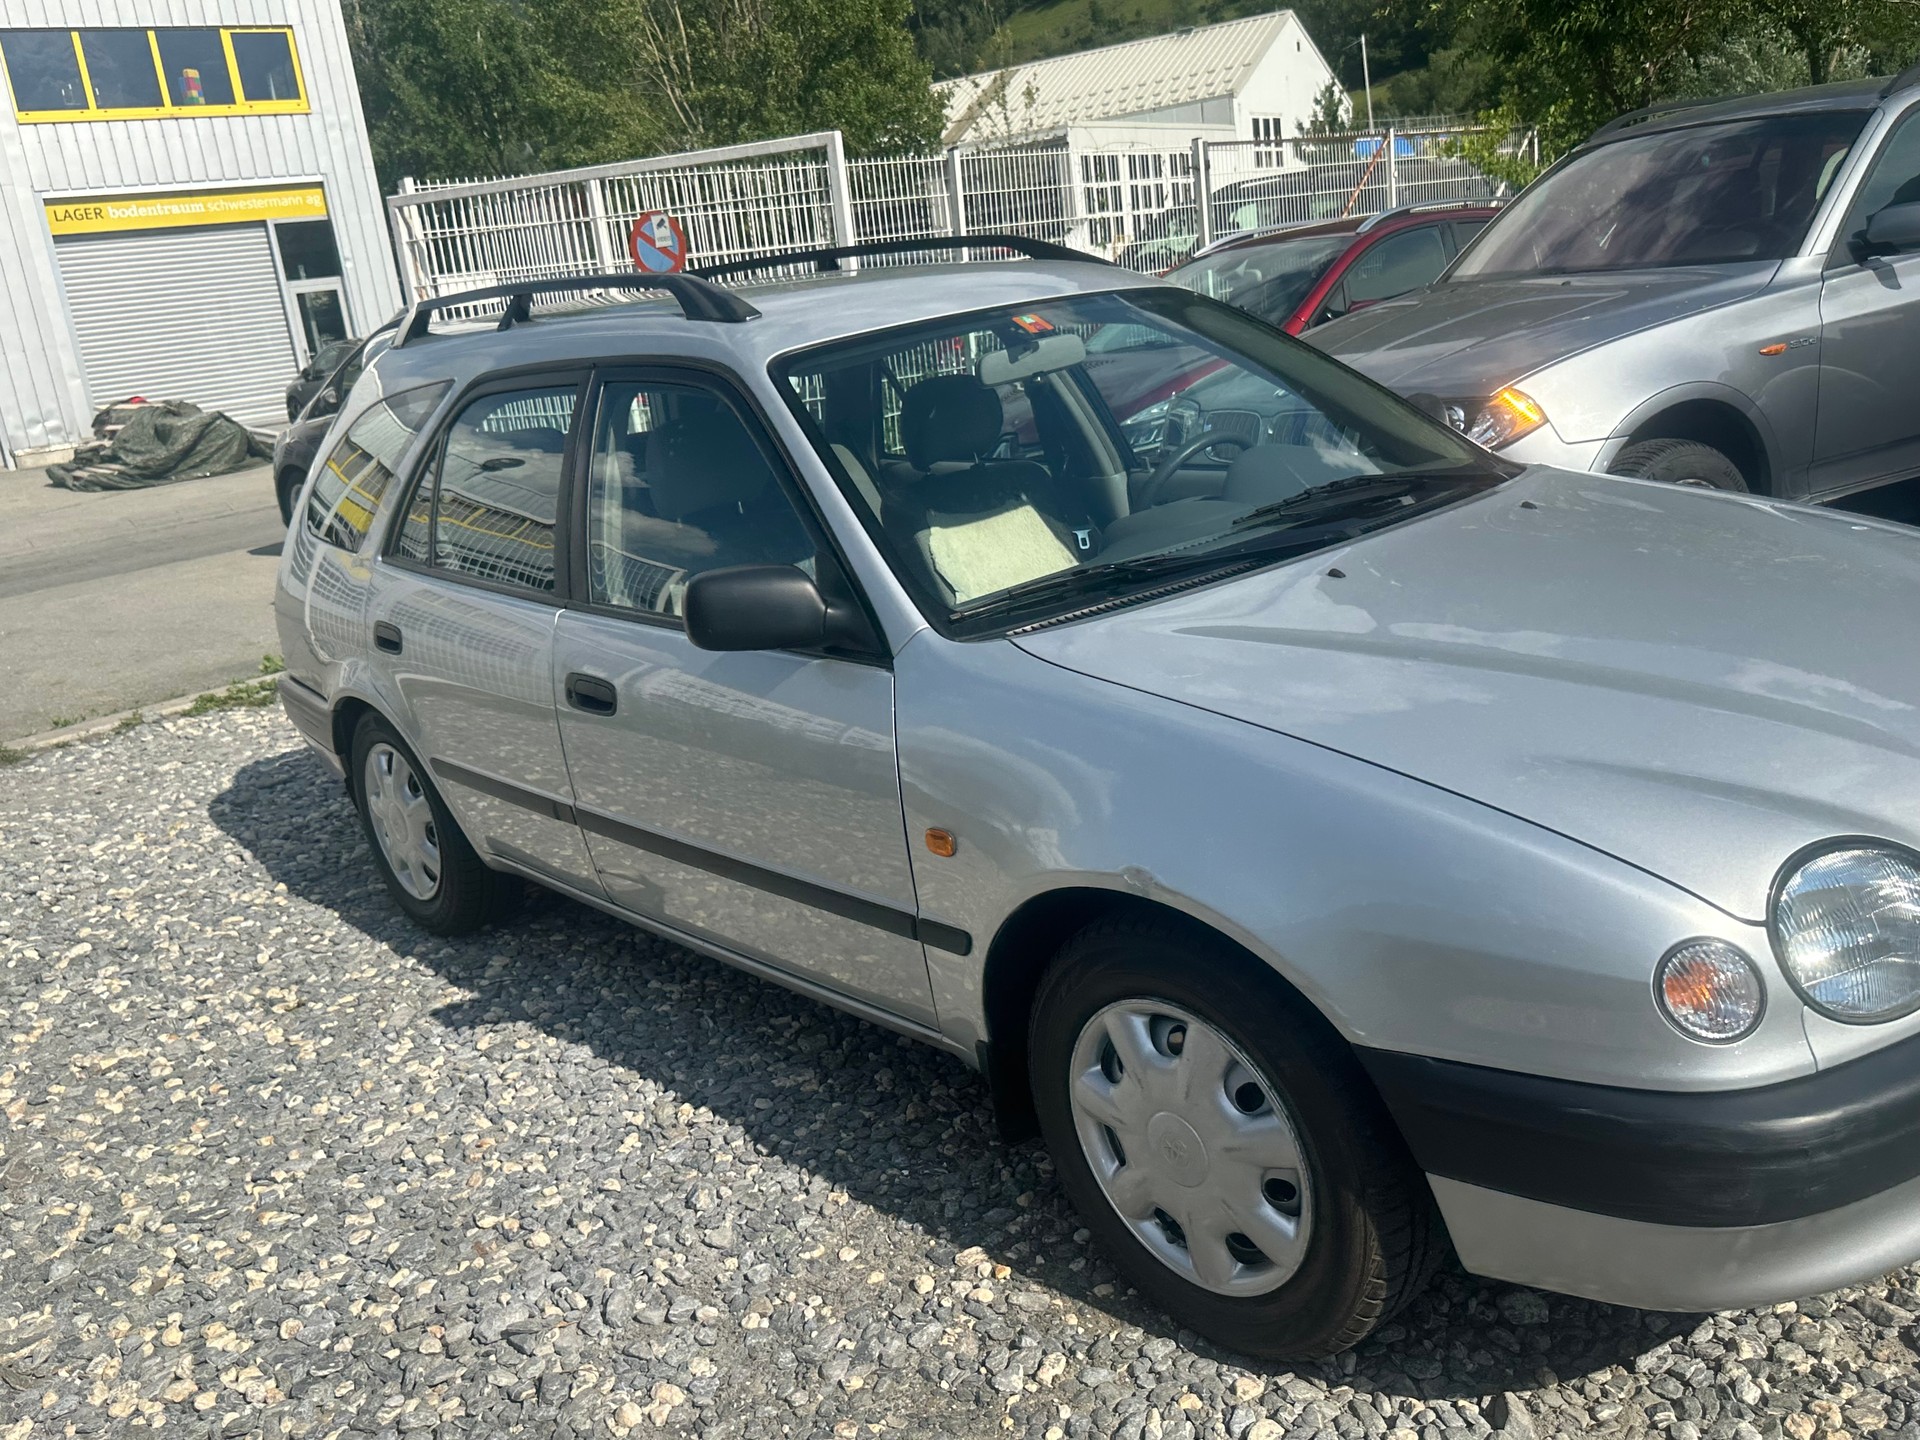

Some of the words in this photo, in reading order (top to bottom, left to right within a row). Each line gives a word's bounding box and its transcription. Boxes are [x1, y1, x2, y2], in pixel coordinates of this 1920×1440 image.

[53, 207, 104, 223] LAGER
[108, 202, 205, 219] bodentraum
[207, 195, 303, 211] schwestermann
[305, 193, 321, 207] ag
